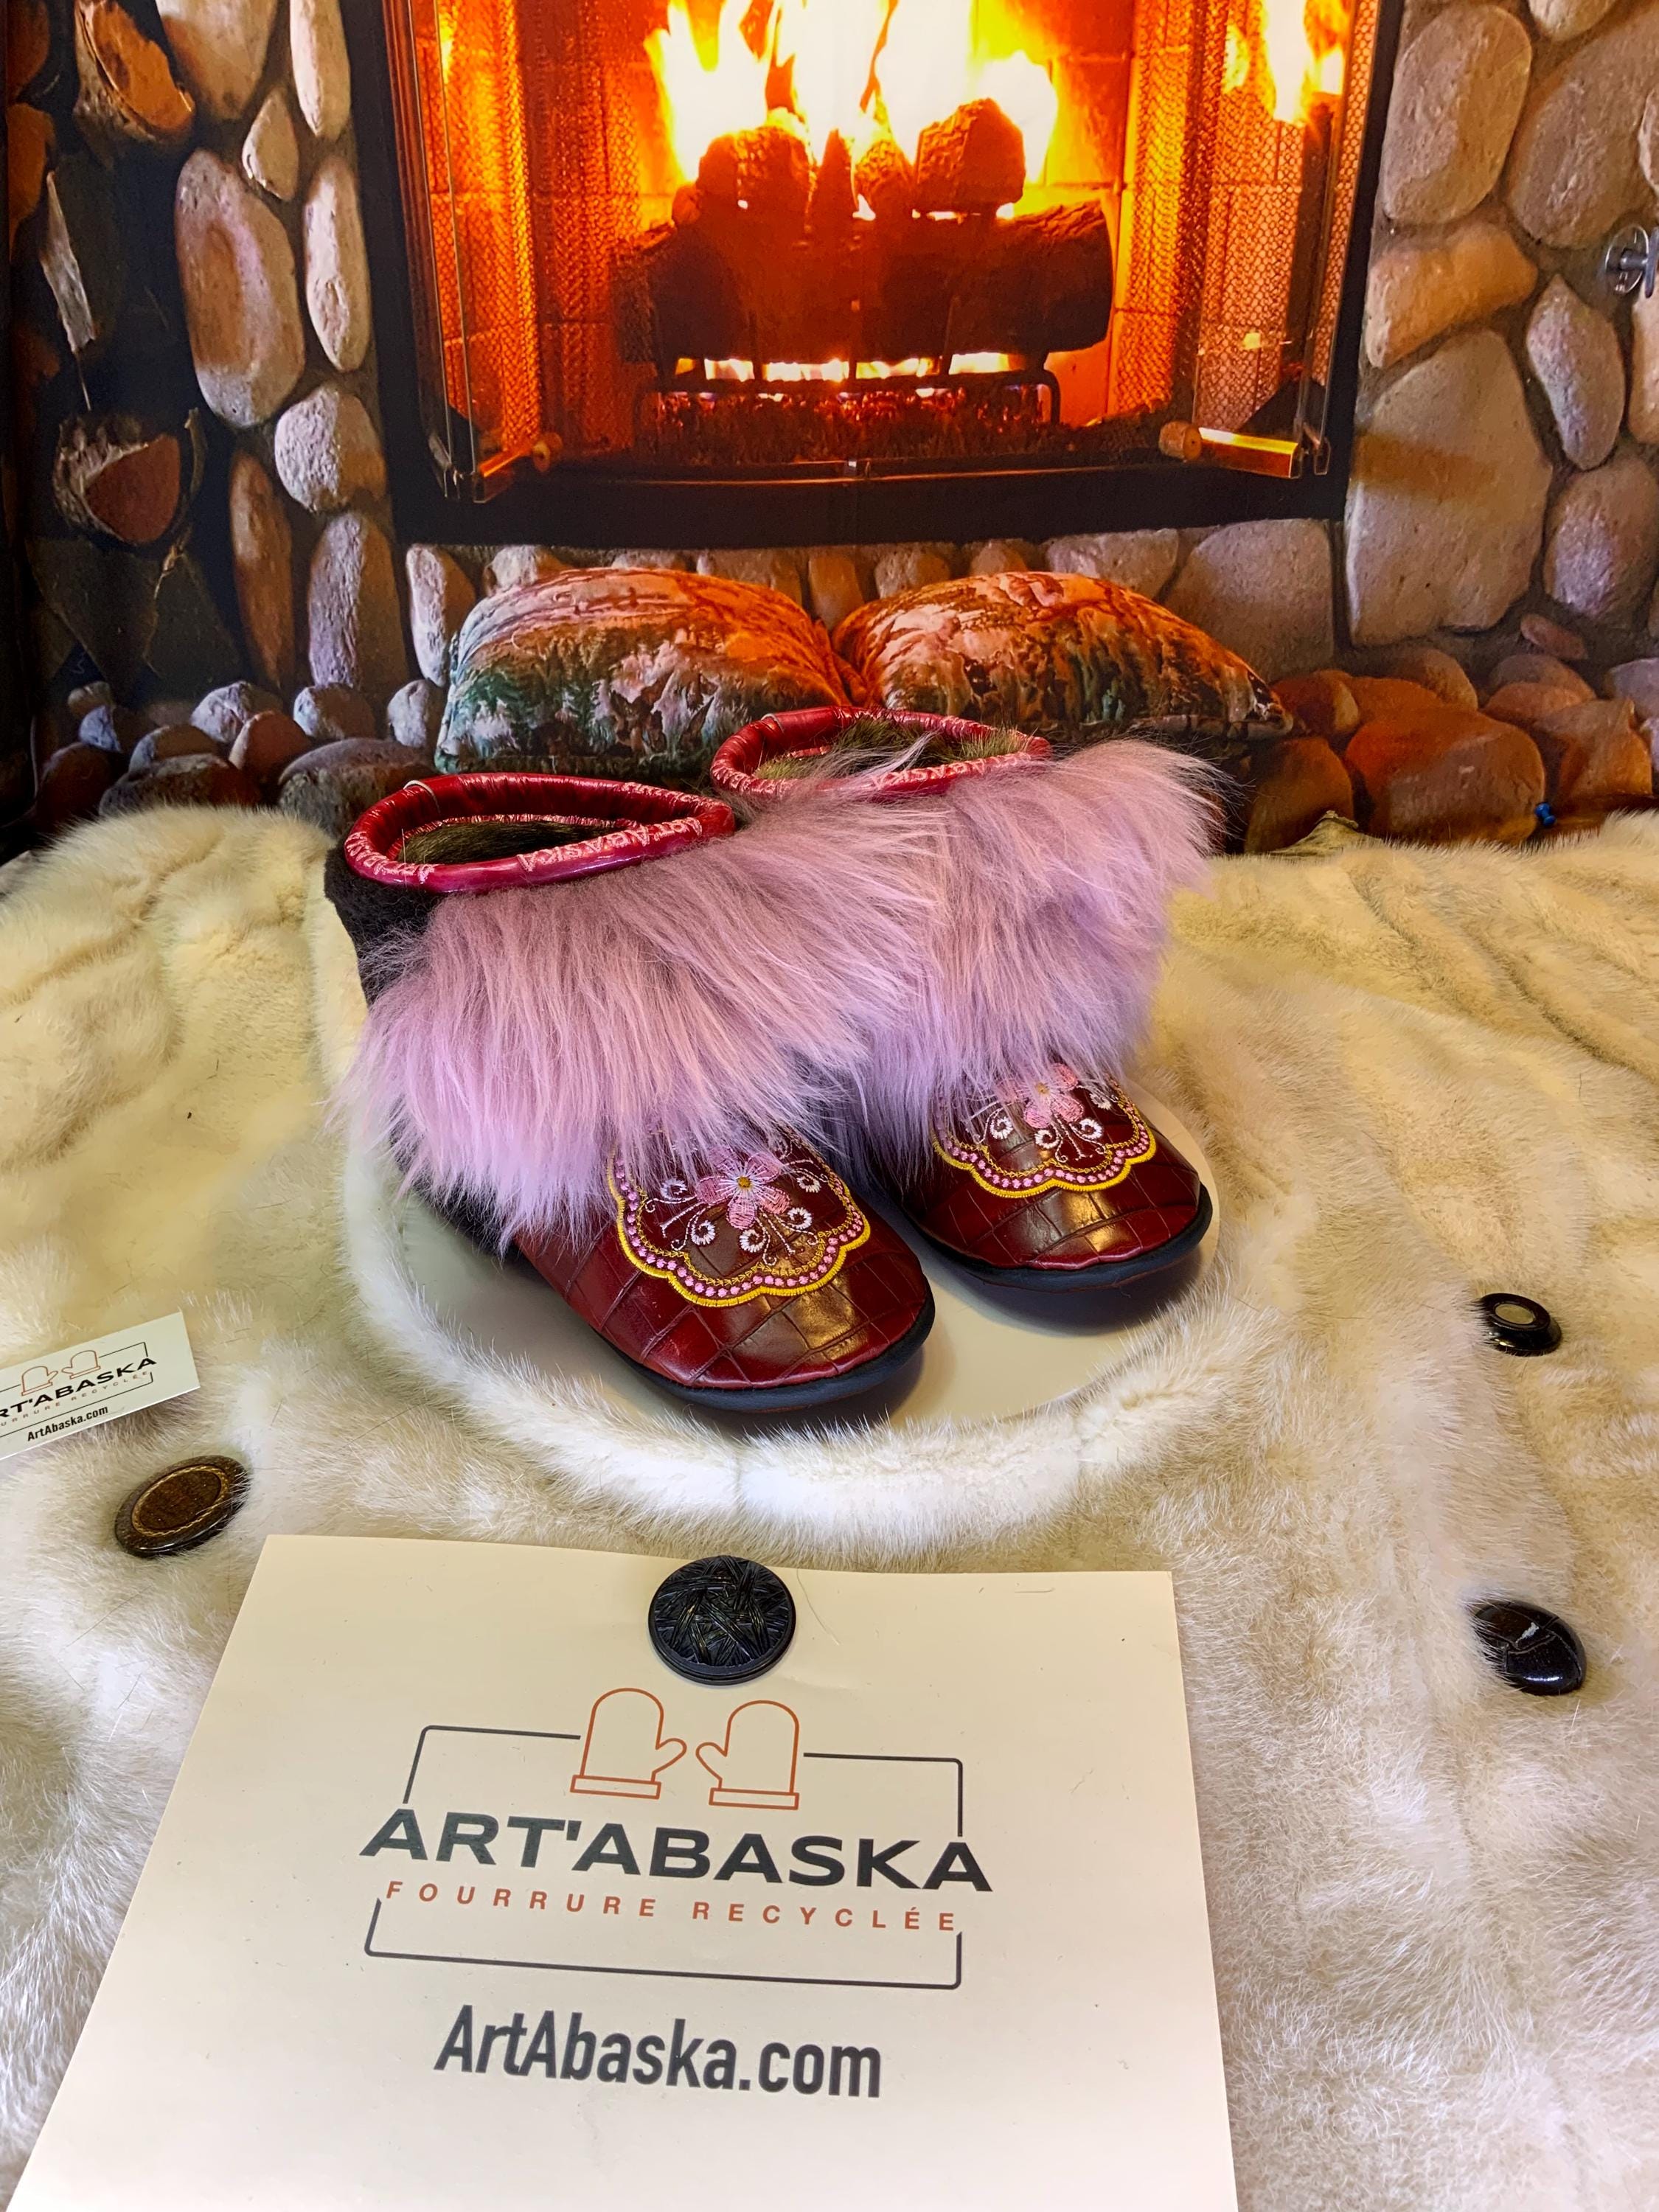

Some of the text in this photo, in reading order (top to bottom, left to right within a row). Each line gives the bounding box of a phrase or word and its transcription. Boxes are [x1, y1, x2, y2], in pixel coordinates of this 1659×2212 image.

[0, 1357, 157, 1418] RT'ABASKA
[27, 1406, 109, 1442] ArtAbaska.com
[358, 1808, 993, 1893] ART'ABASKA
[386, 1879, 956, 1932] FOURRURE RECYCLÉE
[433, 2004, 881, 2099] ArtAbaska.com
